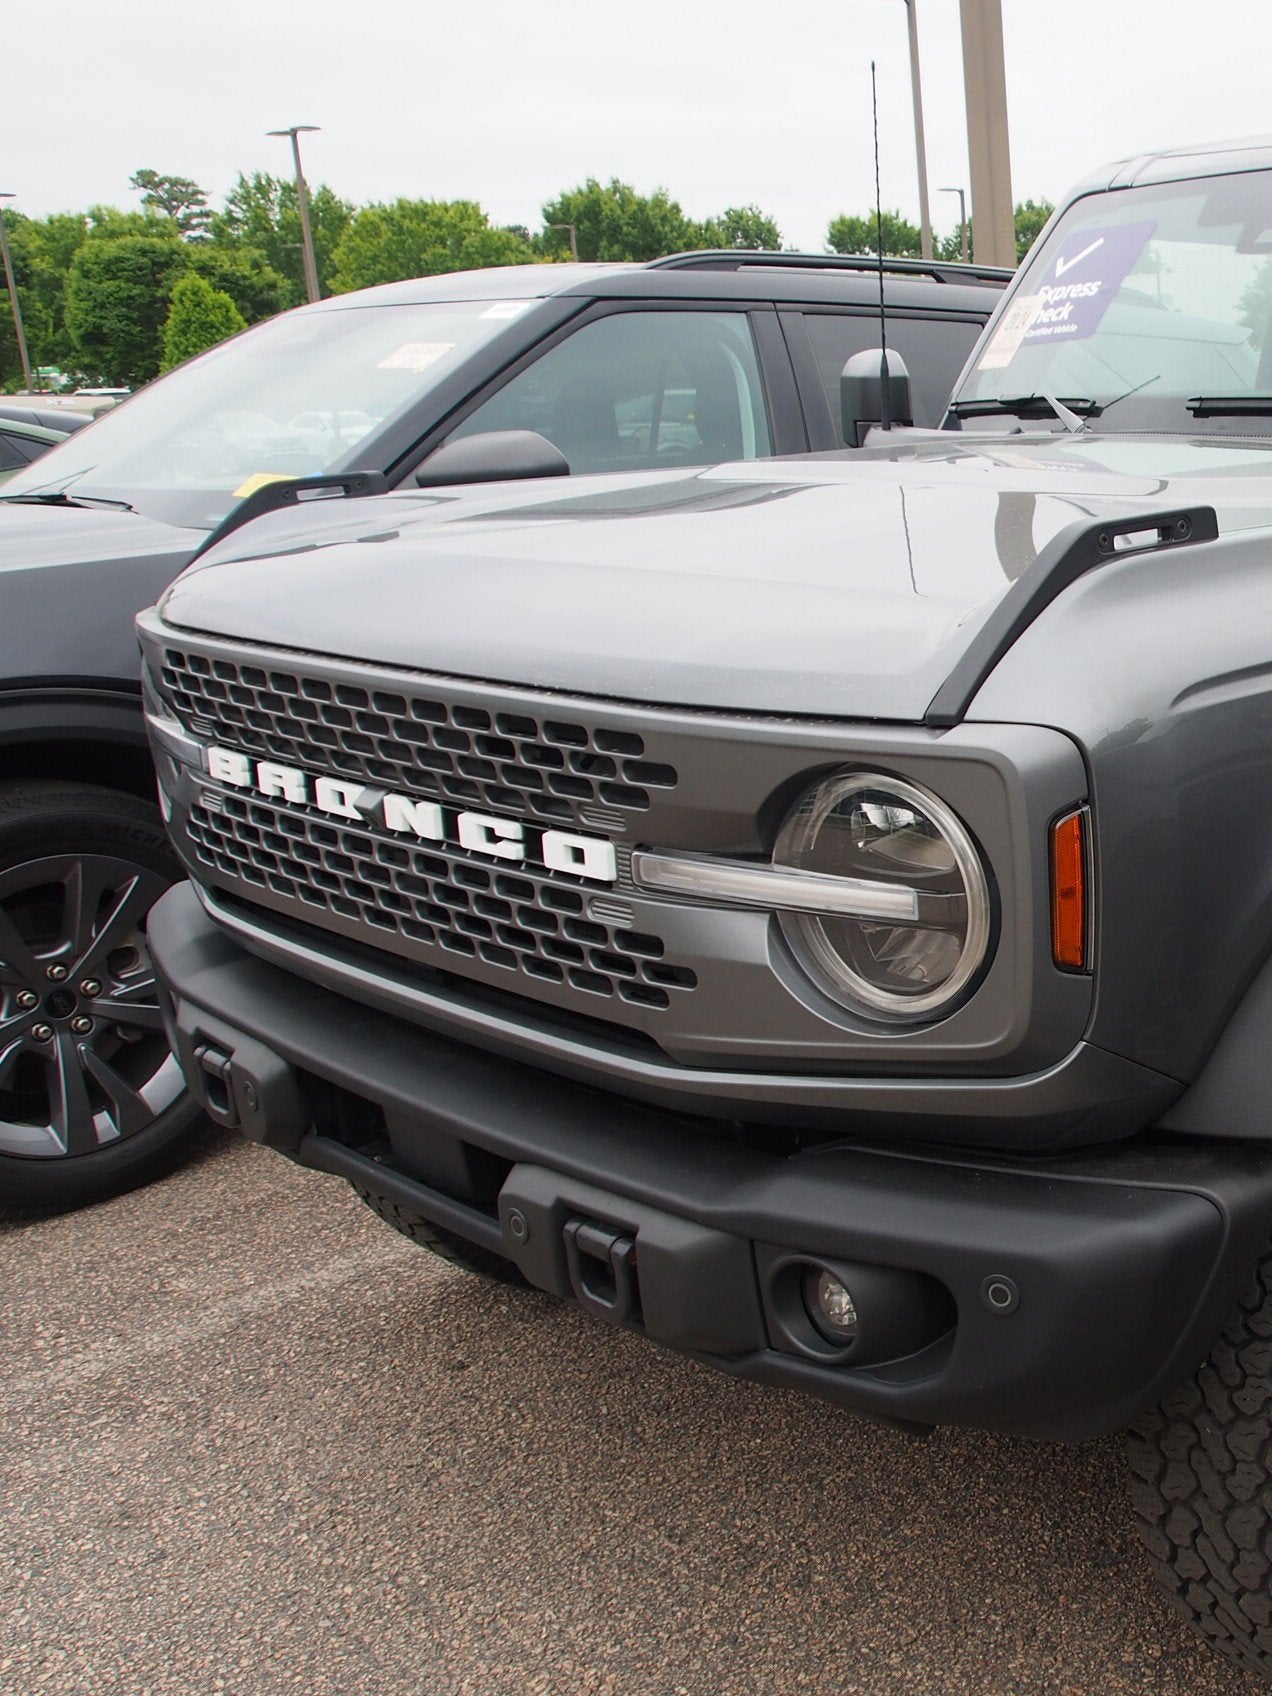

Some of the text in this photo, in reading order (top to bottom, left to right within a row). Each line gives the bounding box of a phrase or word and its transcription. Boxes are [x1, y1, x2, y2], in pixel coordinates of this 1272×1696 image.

[1038, 281, 1102, 304] Express
[1033, 301, 1074, 324] heck
[207, 745, 618, 882] BRONCO
